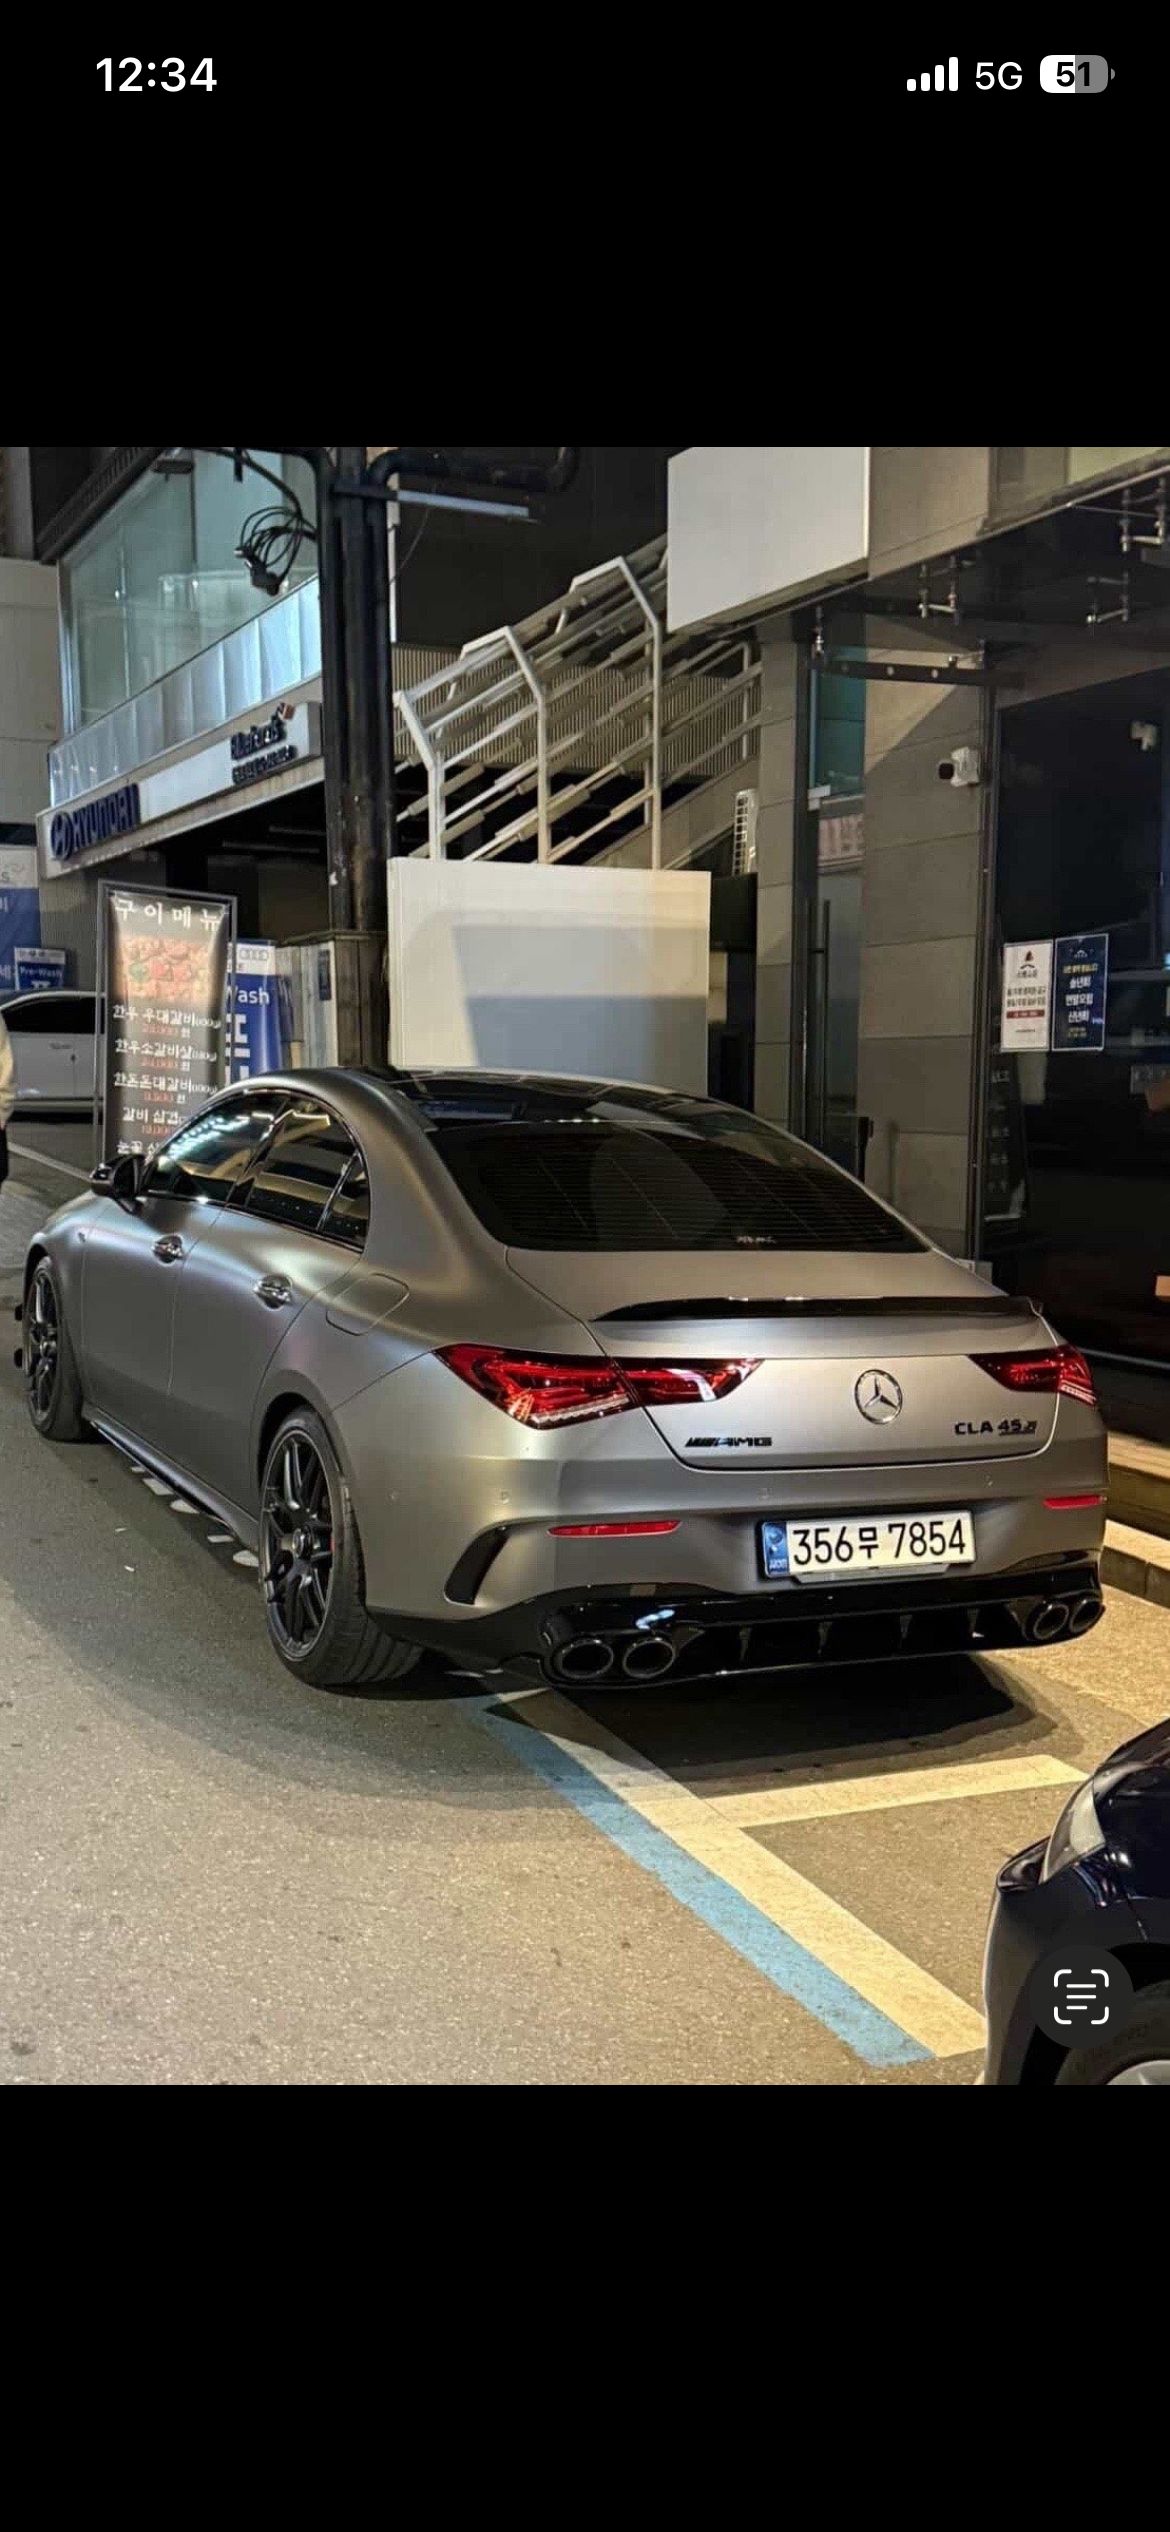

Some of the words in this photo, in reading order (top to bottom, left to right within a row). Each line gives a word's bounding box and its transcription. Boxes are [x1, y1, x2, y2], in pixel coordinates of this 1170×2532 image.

[73, 782, 140, 851] HYUNDAI
[954, 1421, 994, 1435] CLA
[792, 1525, 880, 1566] 356무
[887, 1518, 967, 1559] 7854
